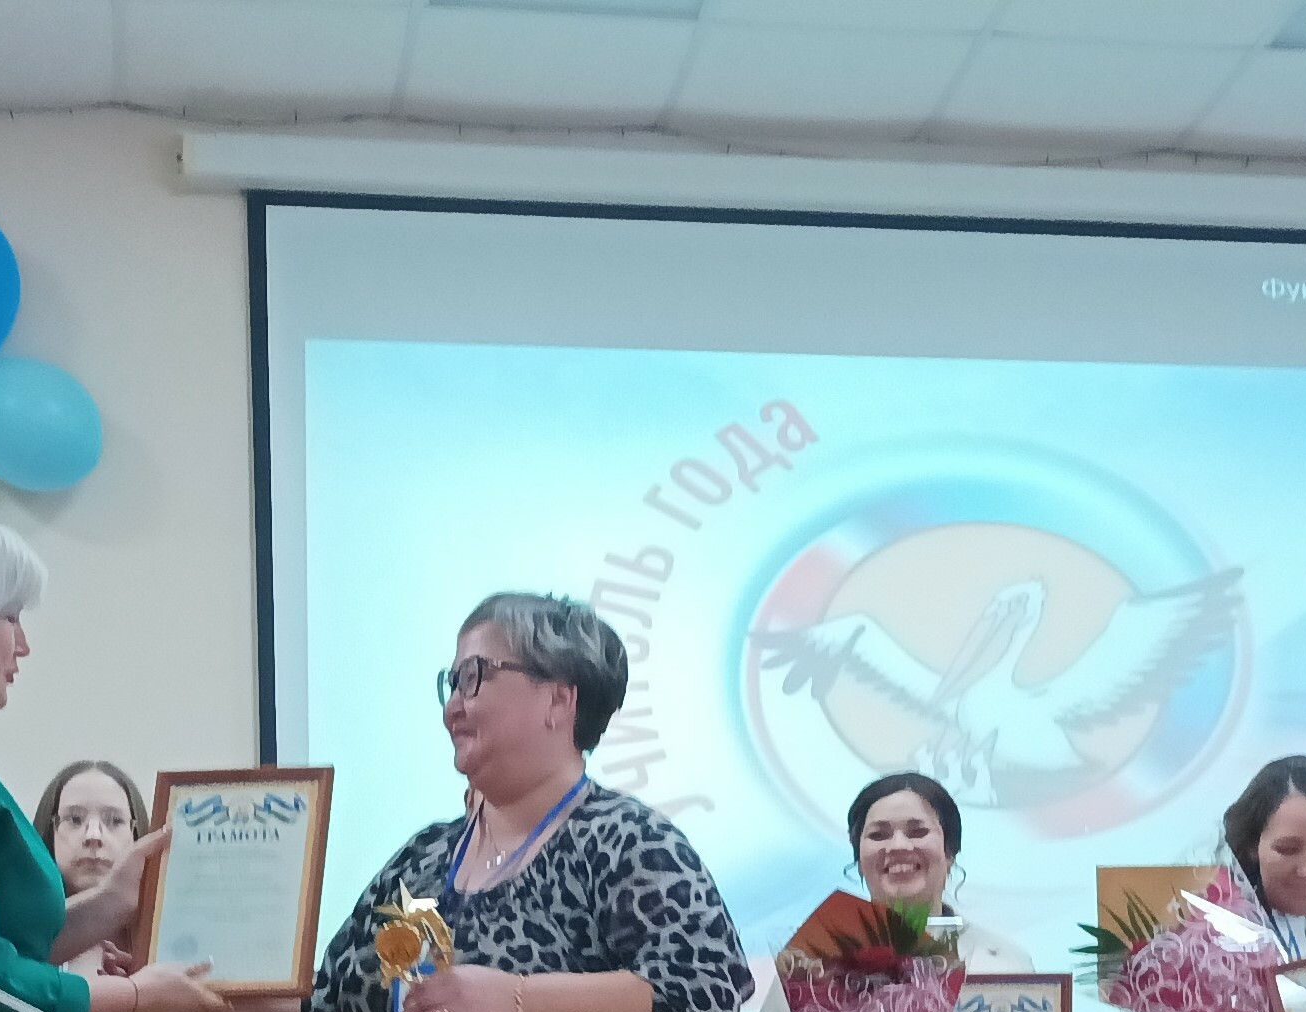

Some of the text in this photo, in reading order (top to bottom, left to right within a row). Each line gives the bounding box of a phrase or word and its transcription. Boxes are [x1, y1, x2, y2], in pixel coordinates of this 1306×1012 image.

[590, 399, 820, 823] училь года
[196, 828, 280, 844] ГРАМОТА
